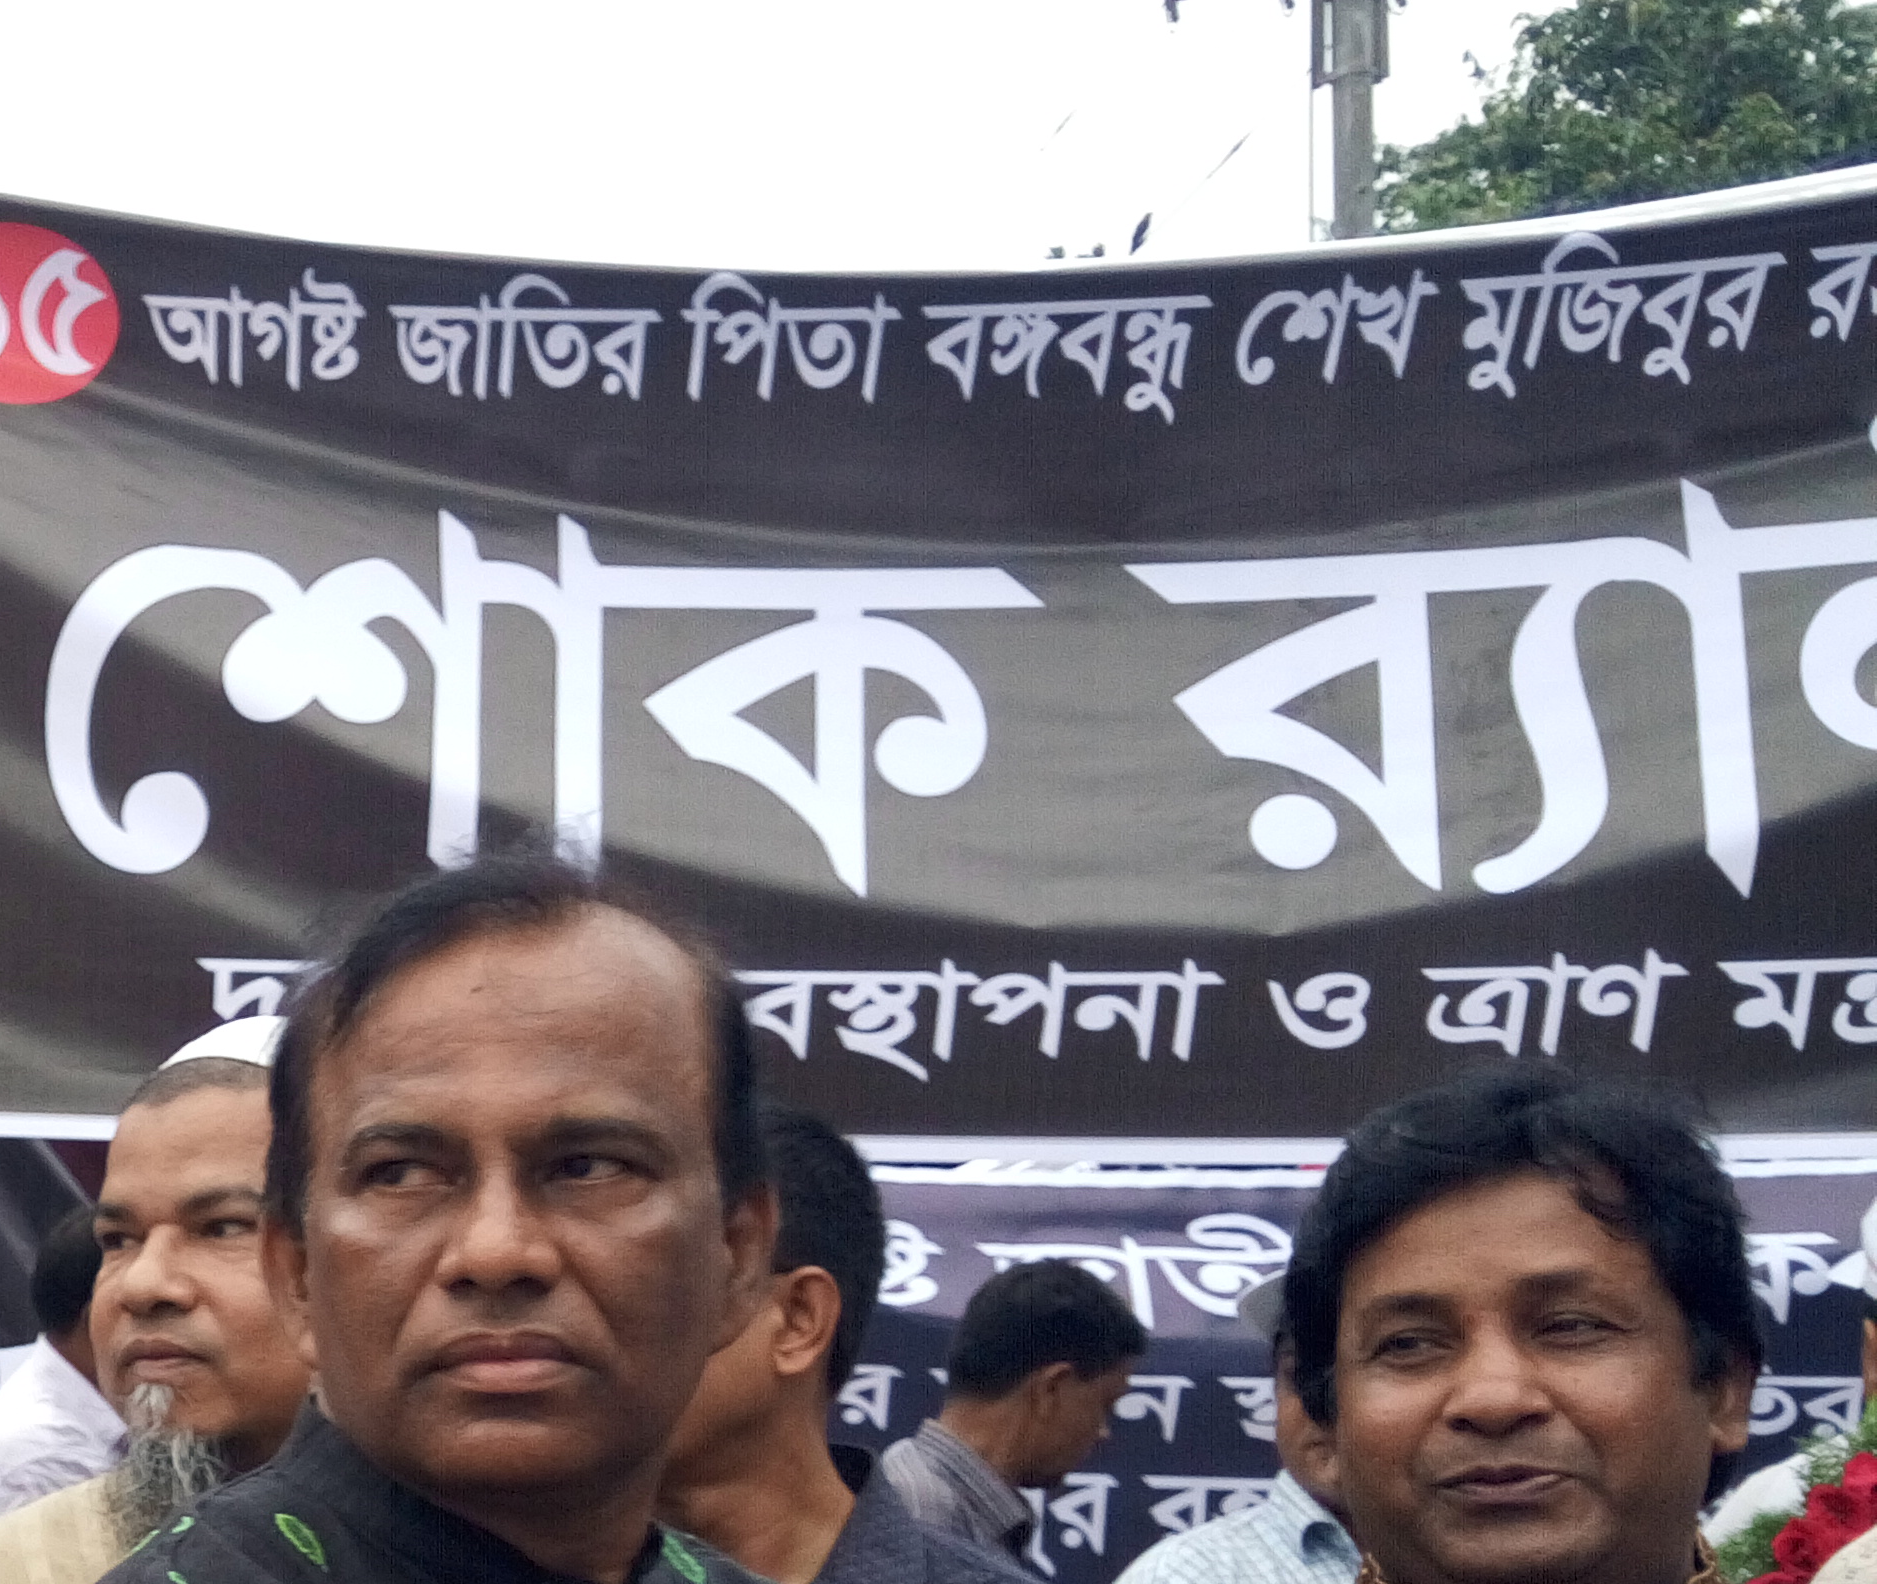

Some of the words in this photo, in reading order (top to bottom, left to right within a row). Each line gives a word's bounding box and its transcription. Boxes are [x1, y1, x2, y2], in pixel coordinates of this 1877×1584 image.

[143, 268, 366, 391] আগষ্ট
[390, 273, 658, 400] জাতির
[683, 271, 900, 403] পিতা
[925, 295, 1215, 424] বঙ্গবন্ধু
[1236, 268, 1439, 385] শেখ
[1461, 231, 1788, 398] মুজিবুর
[43, 507, 1044, 900] শোক
[1267, 972, 1372, 1051] ও
[1421, 948, 1690, 1057] ত্রাণ
